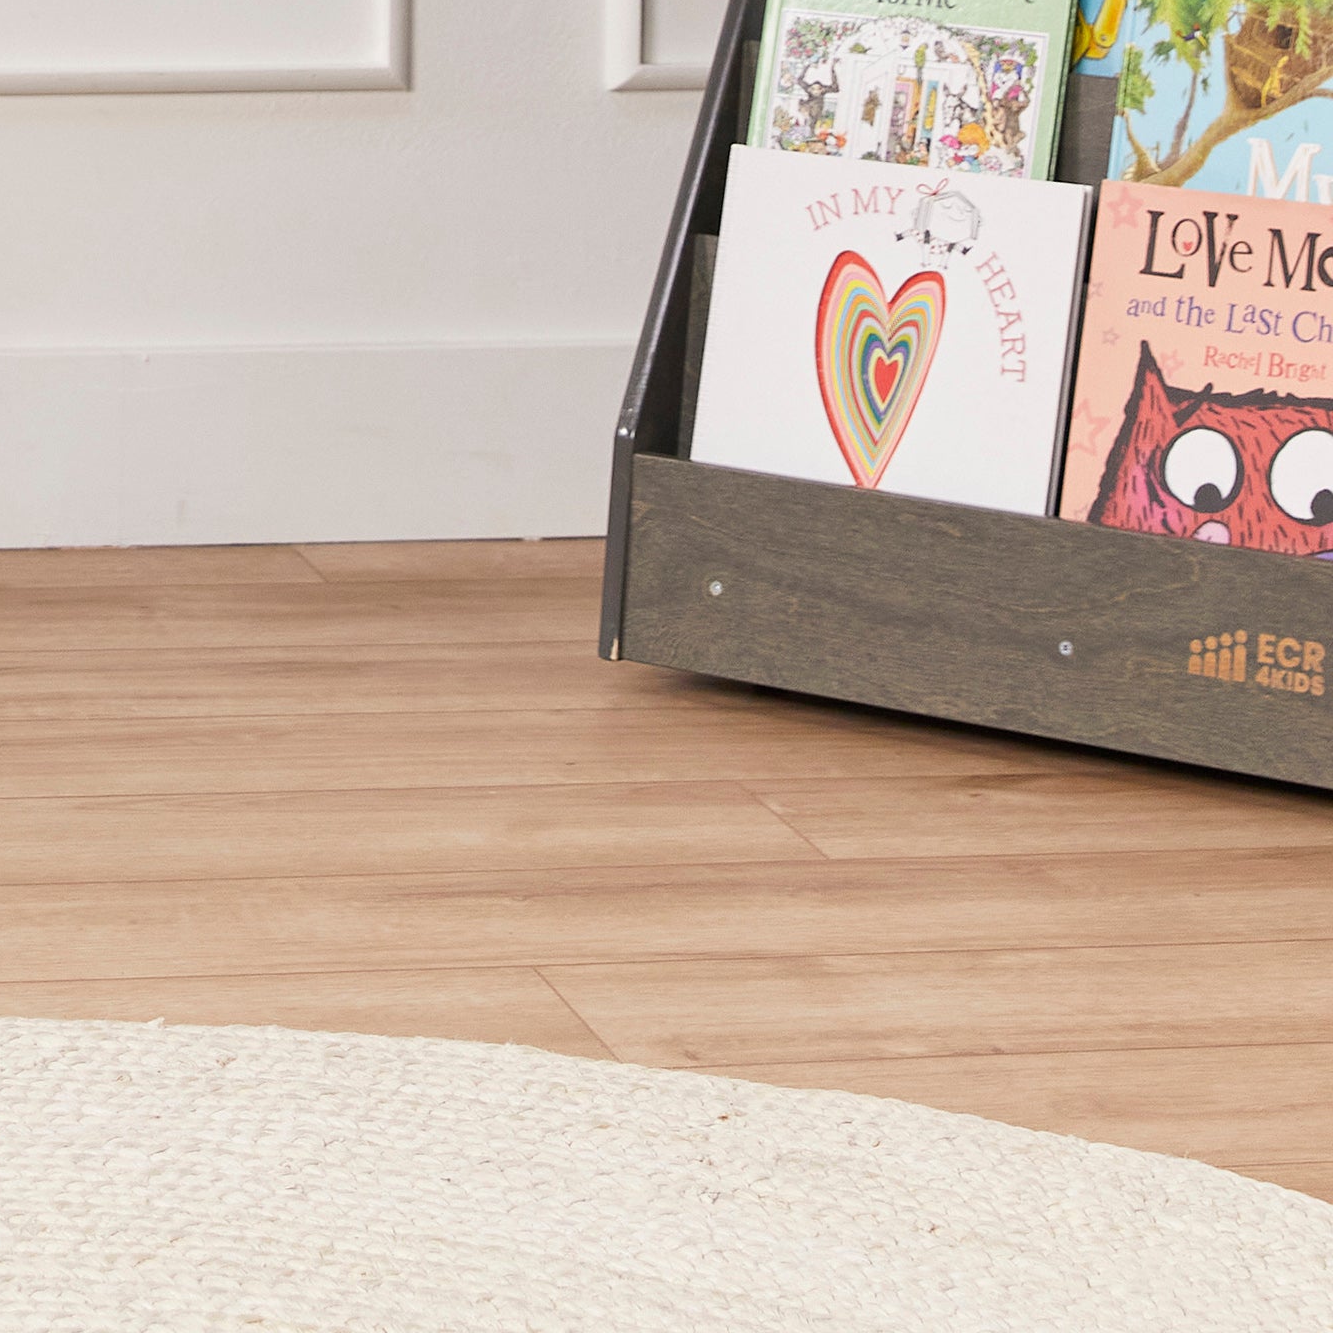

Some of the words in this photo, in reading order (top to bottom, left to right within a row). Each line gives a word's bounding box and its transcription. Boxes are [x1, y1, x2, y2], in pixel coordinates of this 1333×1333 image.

[804, 193, 843, 232] IN
[852, 185, 905, 217] MY
[976, 251, 1027, 383] HEART
[1126, 296, 1167, 318] and
[1175, 296, 1215, 328] the
[1204, 345, 1262, 376] Rachel
[1267, 352, 1327, 382] Bright
[1256, 633, 1326, 673] ECR
[1254, 665, 1326, 697] 4KIDS
